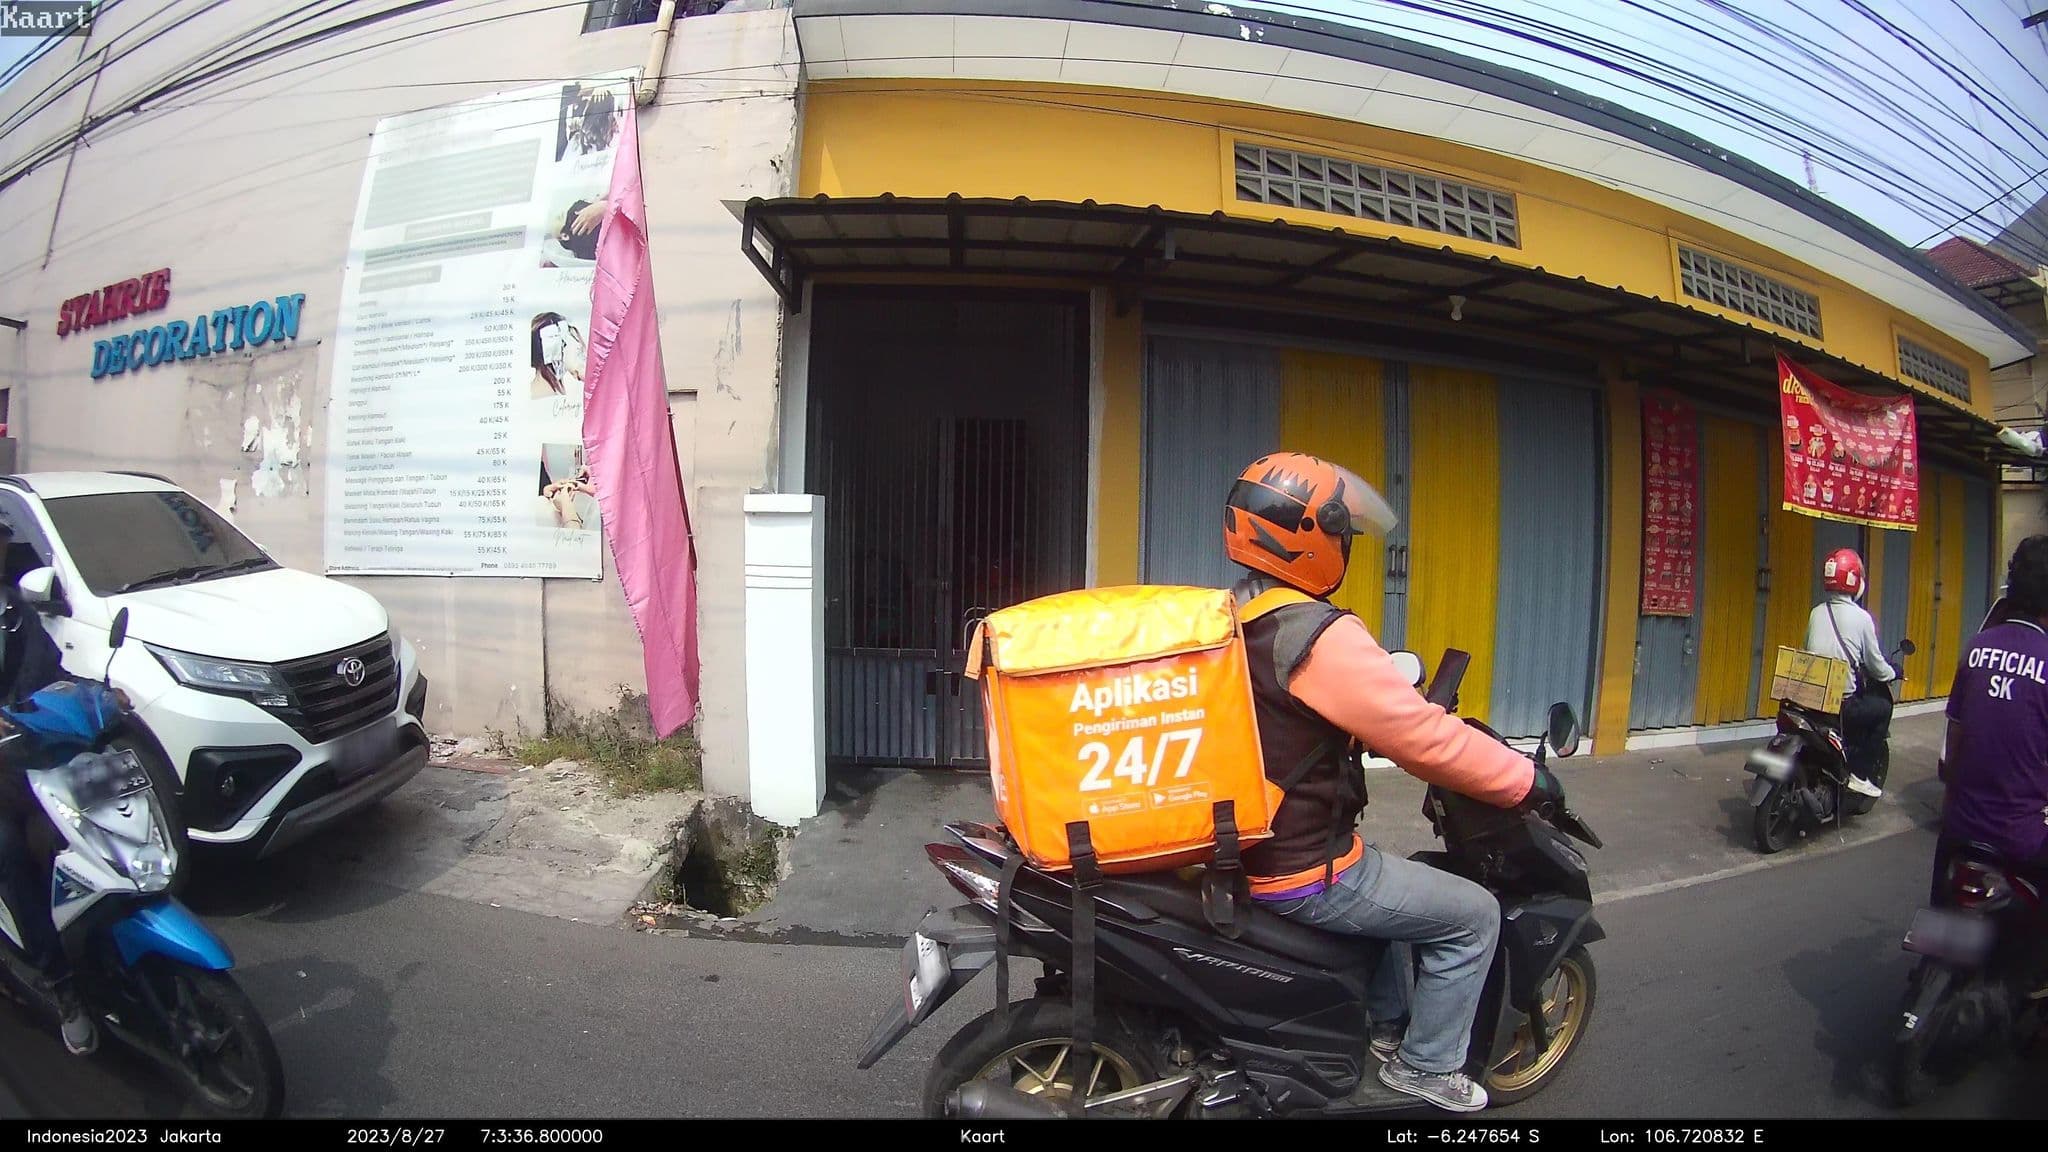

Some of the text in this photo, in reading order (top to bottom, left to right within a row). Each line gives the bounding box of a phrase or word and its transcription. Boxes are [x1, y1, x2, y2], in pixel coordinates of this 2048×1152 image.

[91, 293, 305, 379] DECORATION
[1968, 648, 2047, 684] OFFICIAL
[1987, 675, 2015, 700] SK
[1069, 667, 1198, 717] Aplikasi
[1073, 708, 1205, 737] Pengiriman Instan
[1077, 728, 1203, 792] 24/7
